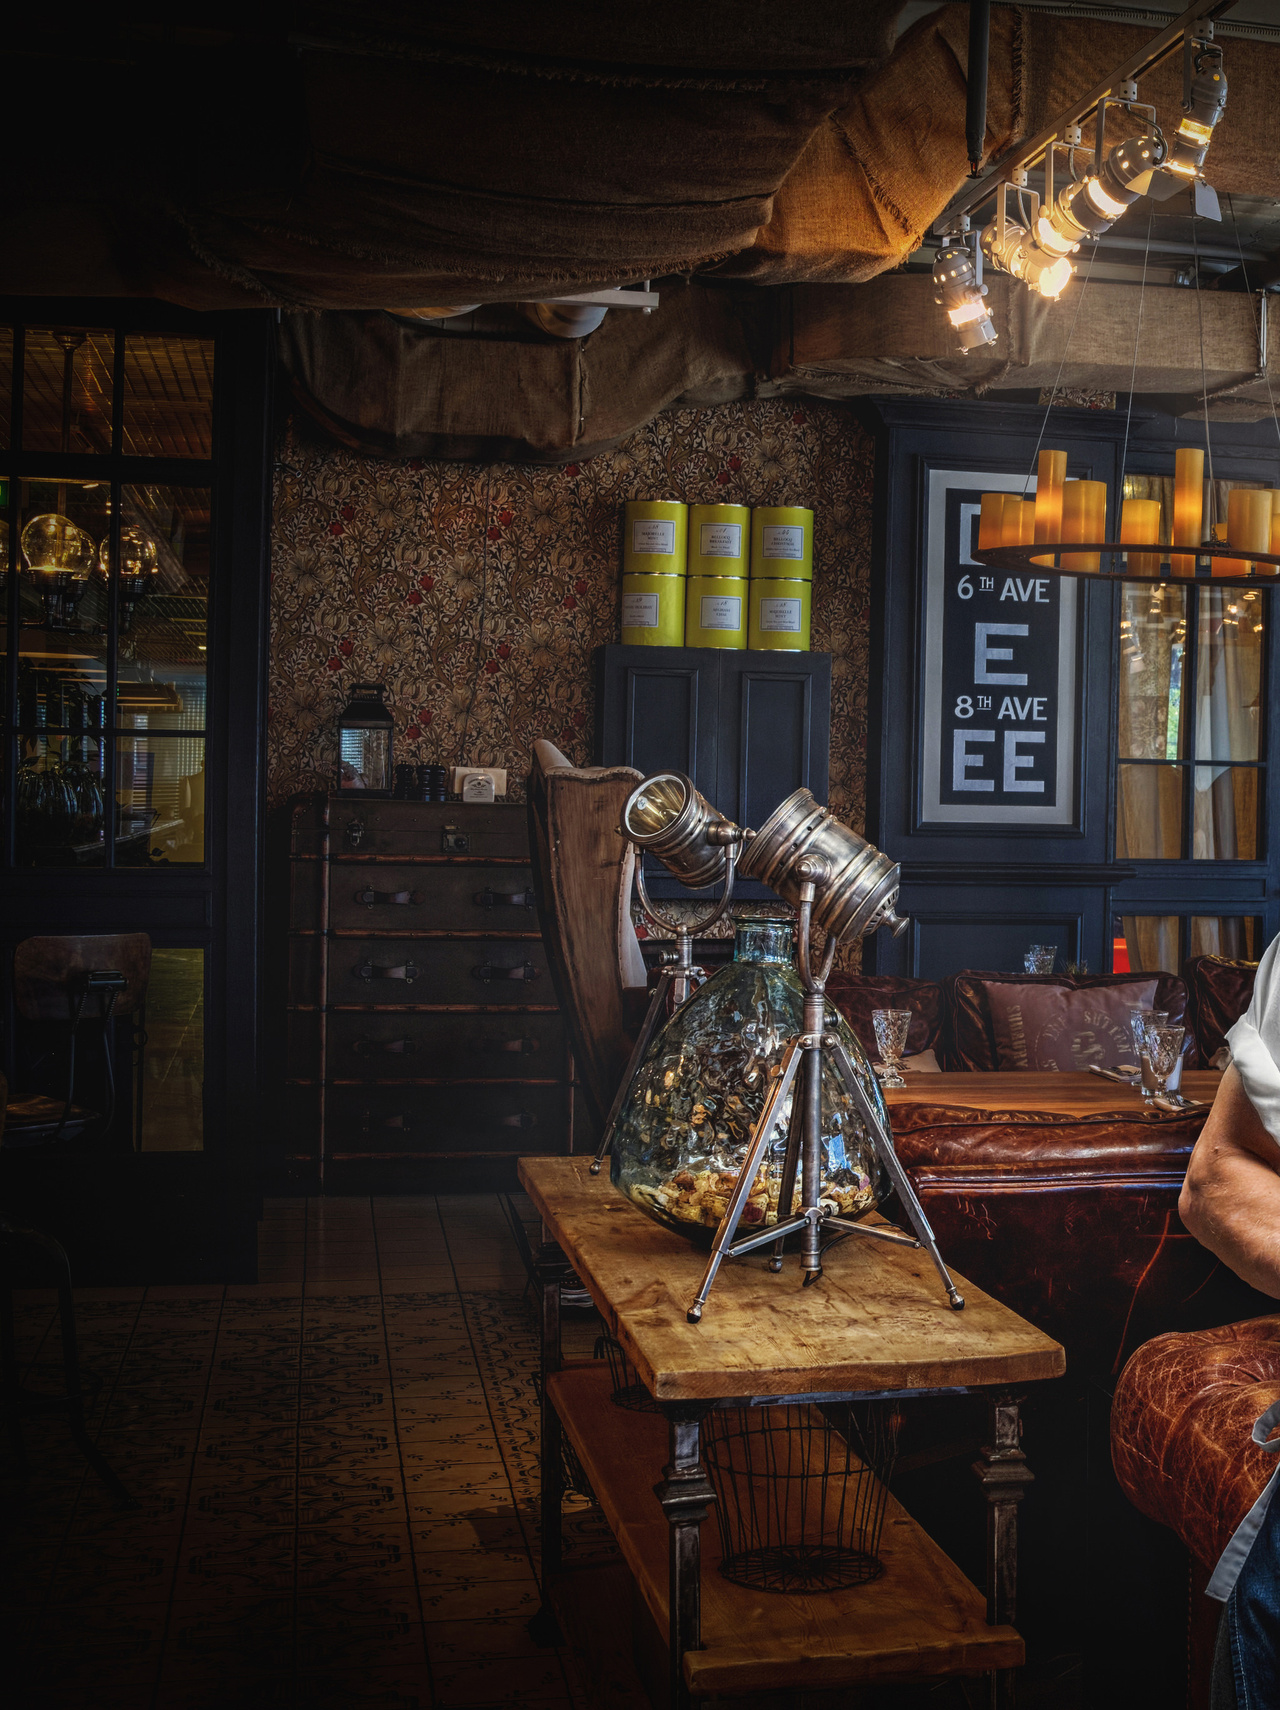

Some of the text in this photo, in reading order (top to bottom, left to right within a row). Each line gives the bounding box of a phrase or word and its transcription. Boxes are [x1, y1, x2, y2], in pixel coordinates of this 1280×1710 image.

[1000, 578, 1049, 602] AVE
[974, 623, 1029, 685] E
[998, 697, 1047, 720] AVE
[953, 729, 1045, 792] EE
